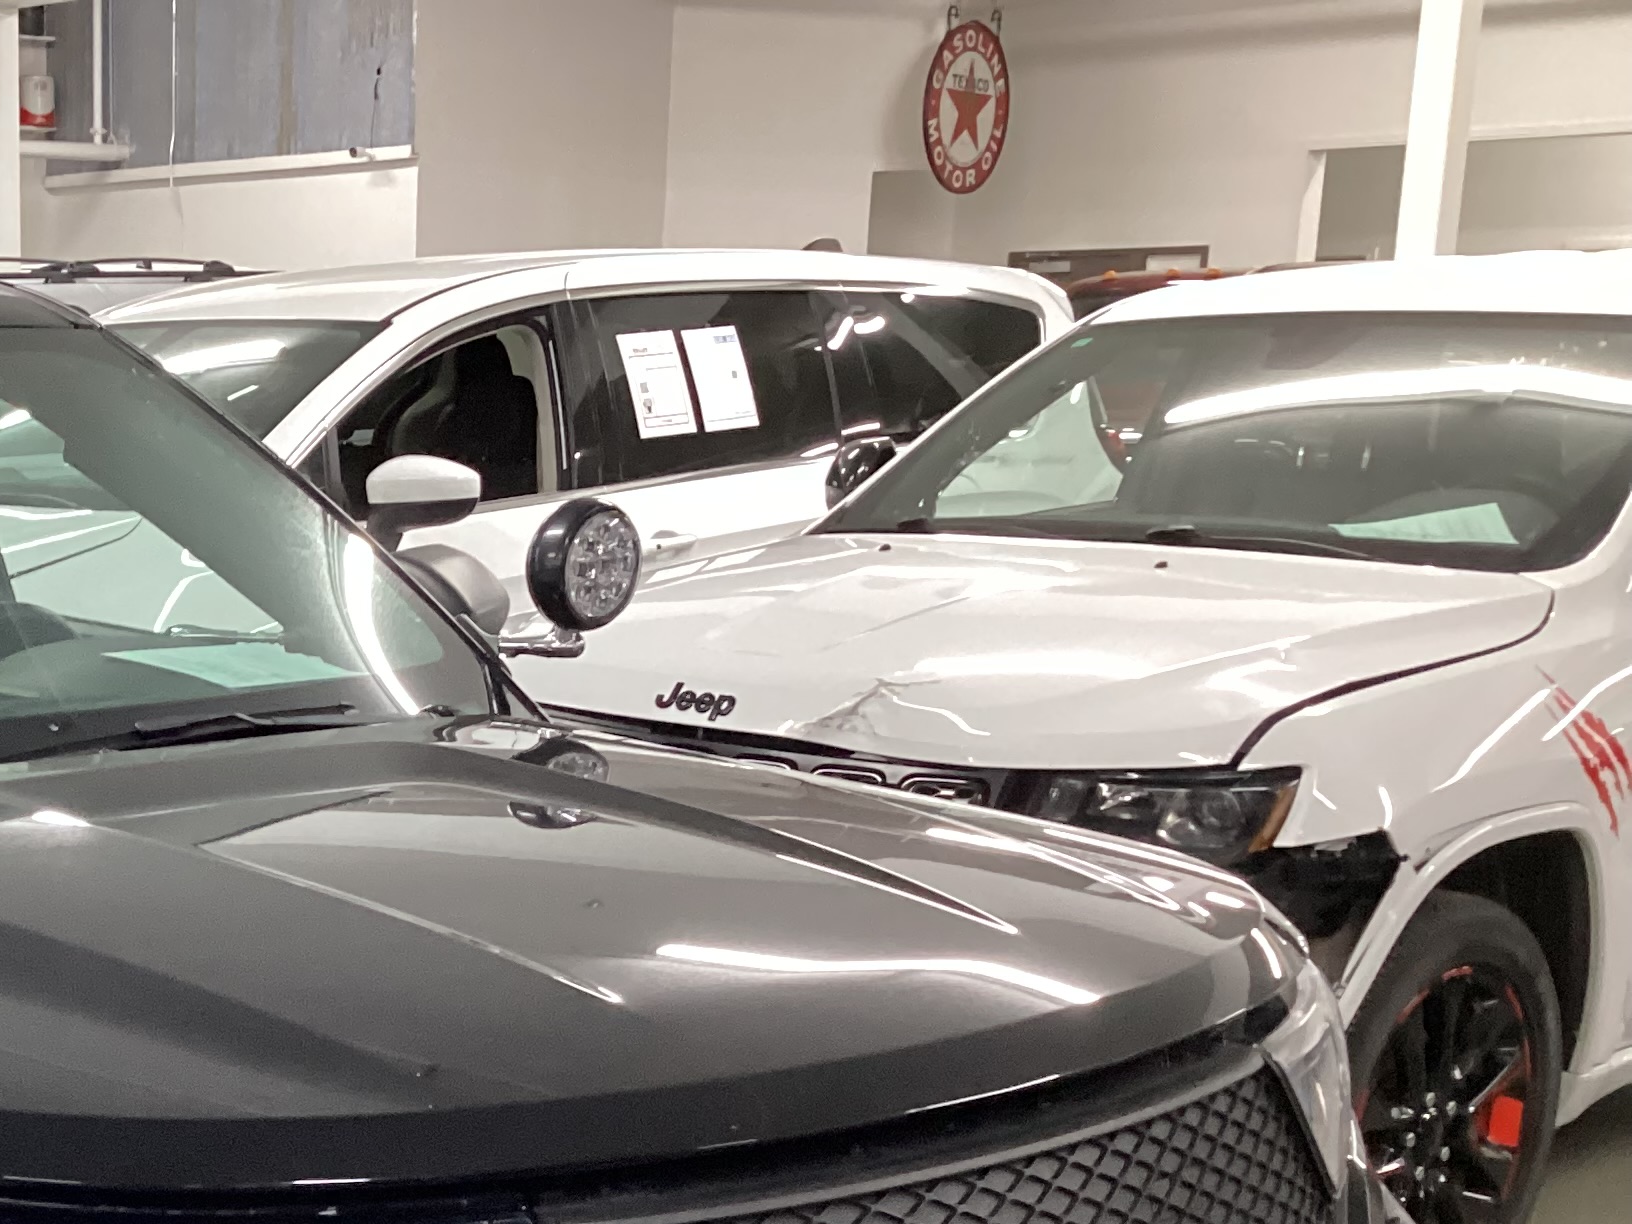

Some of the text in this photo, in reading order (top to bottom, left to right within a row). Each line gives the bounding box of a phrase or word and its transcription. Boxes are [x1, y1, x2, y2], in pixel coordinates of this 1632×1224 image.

[932, 29, 1005, 97] GASOLINE
[952, 73, 990, 92] TEXCO
[927, 119, 1004, 188] MOTOR OIL
[655, 681, 736, 722] Jeep
